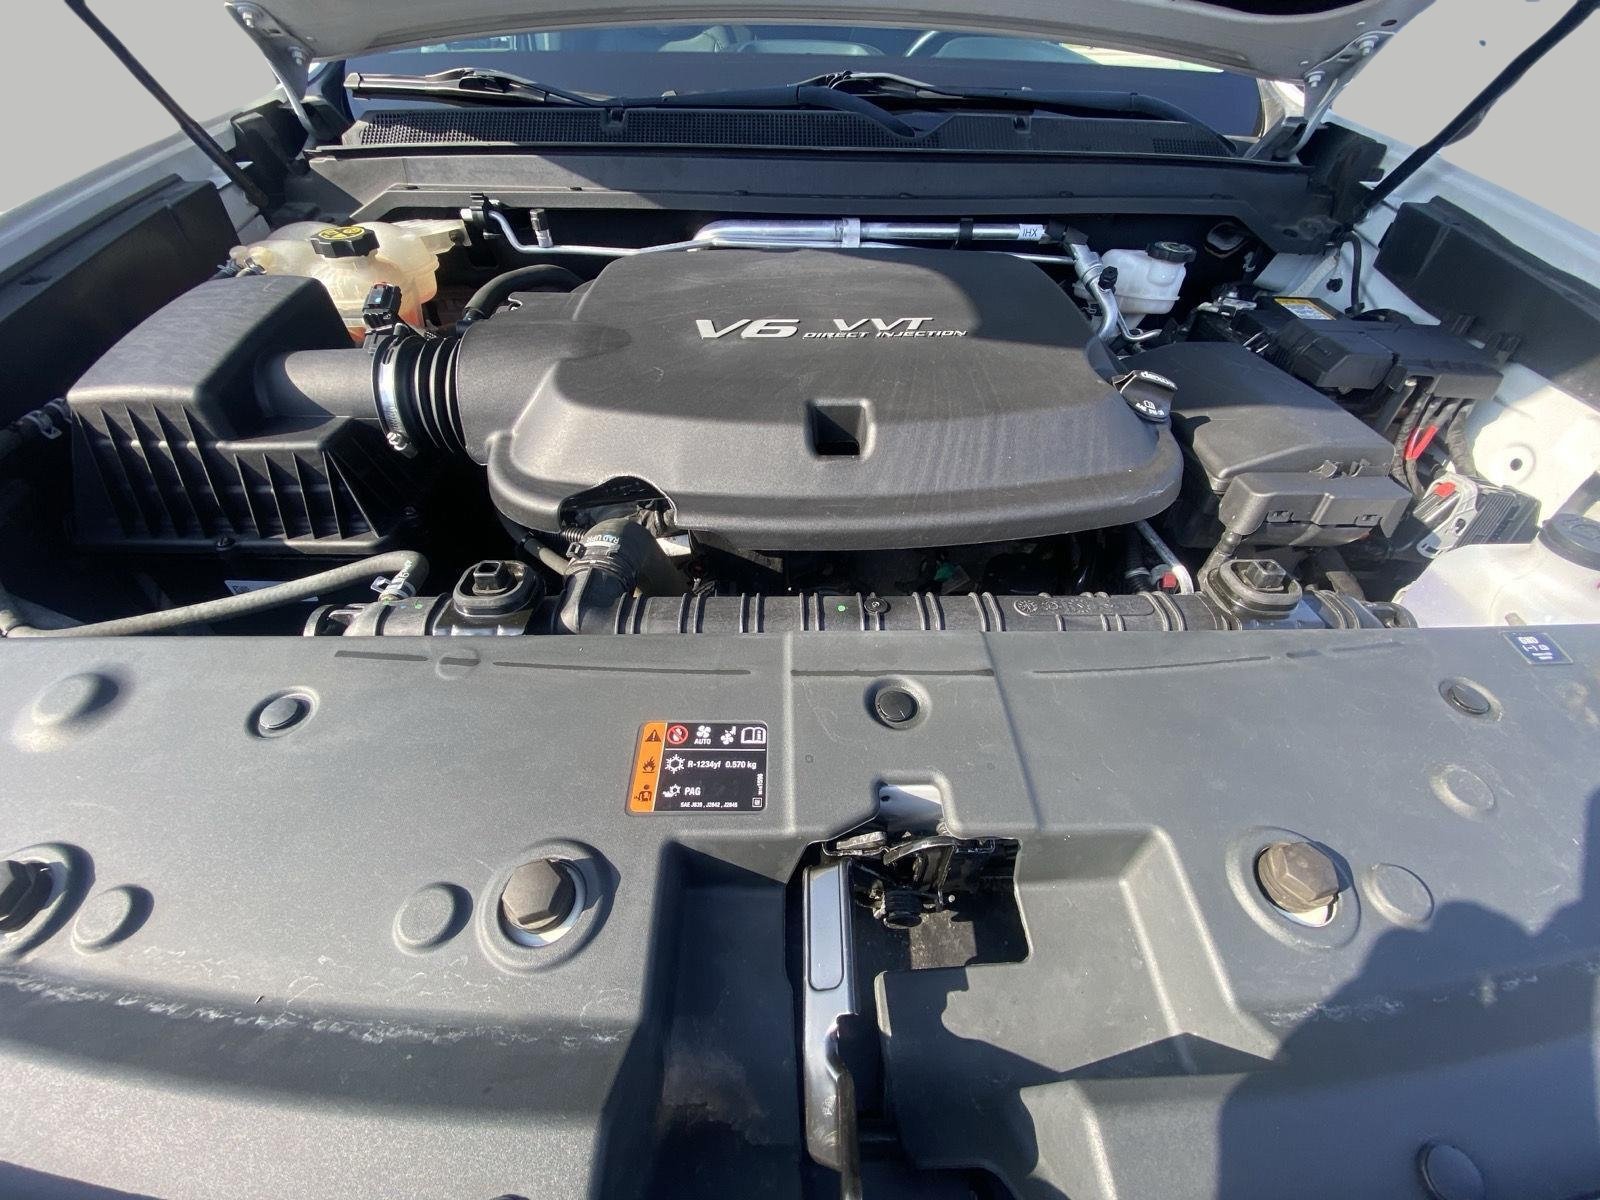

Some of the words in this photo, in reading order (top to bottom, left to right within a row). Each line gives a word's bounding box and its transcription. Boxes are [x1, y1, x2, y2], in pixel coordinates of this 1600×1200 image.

[695, 318, 800, 340] V6
[832, 317, 934, 332] VVT
[802, 331, 870, 340] DIRECT
[876, 330, 968, 339] INJECTION
[687, 760, 721, 770] R-1234yf
[725, 760, 746, 769] 0.570
[746, 760, 757, 770] kg
[684, 786, 701, 797] PAG
